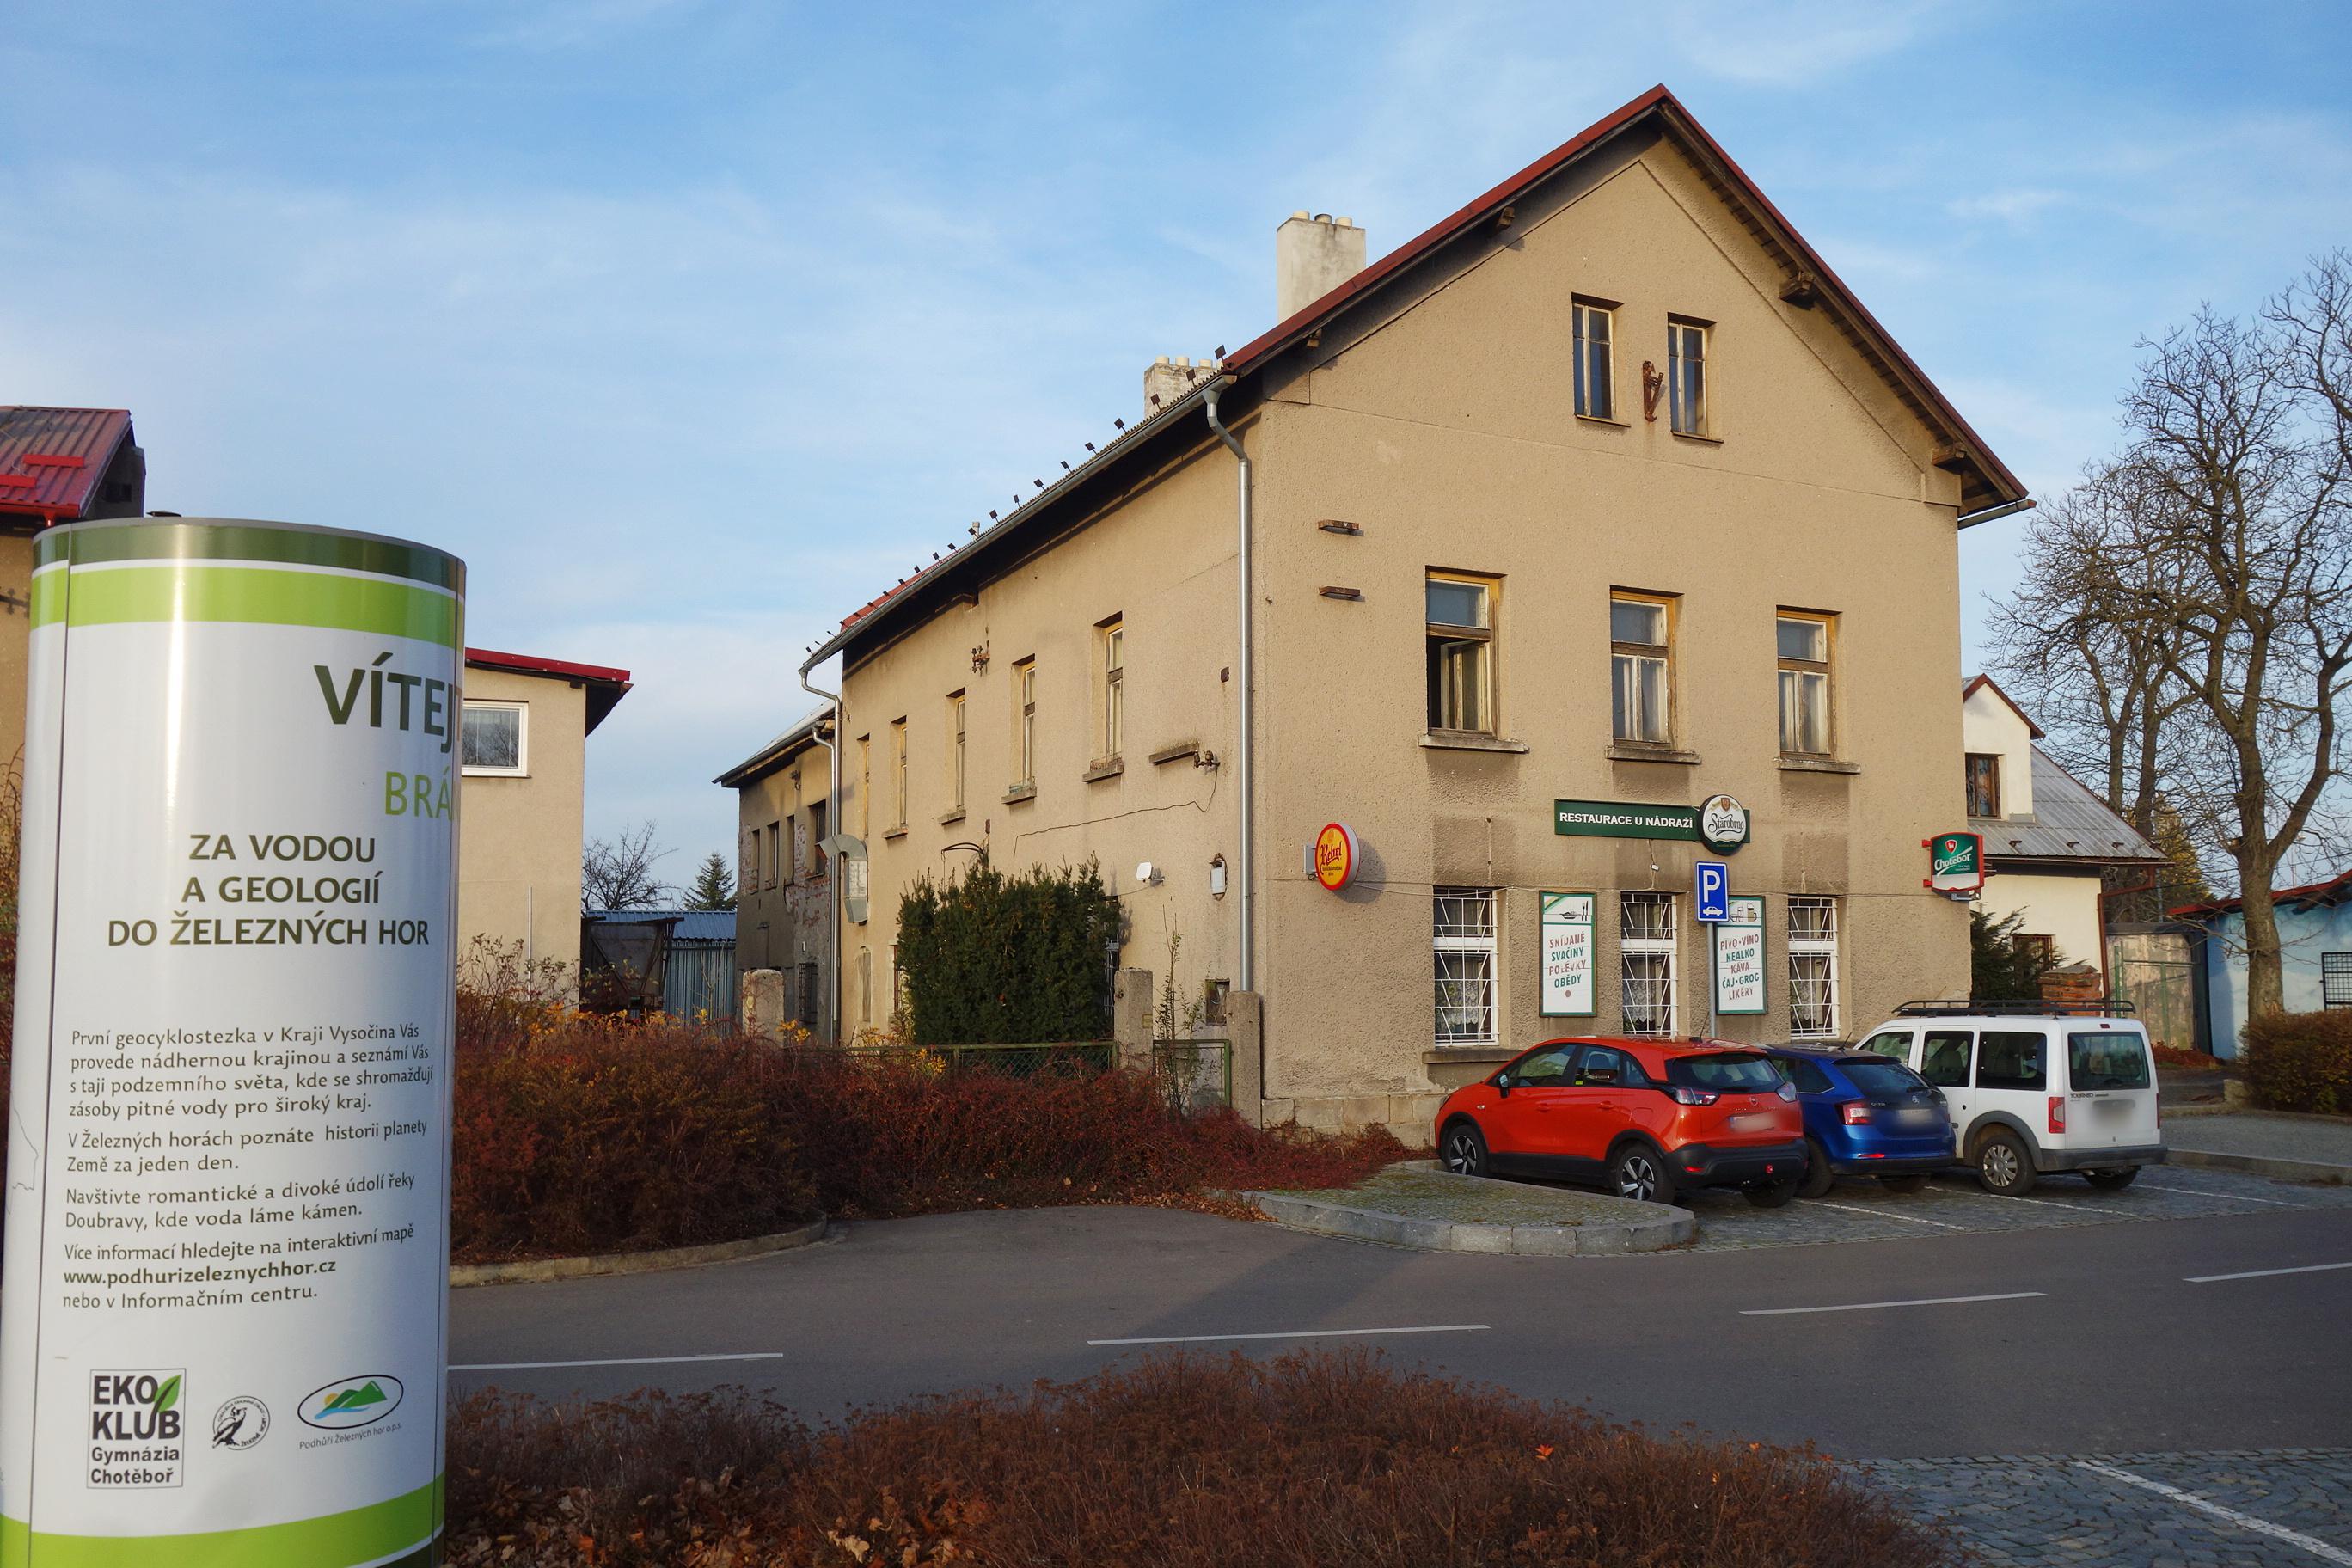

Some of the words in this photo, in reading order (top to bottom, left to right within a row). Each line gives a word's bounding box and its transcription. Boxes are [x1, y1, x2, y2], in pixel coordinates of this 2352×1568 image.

[1559, 812, 1632, 825] RESTAURACE
[1634, 817, 1643, 826] U
[1645, 815, 1693, 829] NÁDRAŽÍ
[1707, 812, 1744, 834] Starobrno
[189, 835, 236, 860] ZA
[249, 835, 375, 862] VODOU
[182, 877, 205, 902] A
[219, 871, 383, 903] GEOLOGIÍ
[1703, 870, 1720, 903] P
[109, 920, 157, 946] DO
[170, 910, 366, 945] ŽELEZNÝCH
[379, 920, 429, 945] HOR
[1726, 948, 1755, 963] NEALKO
[72, 1030, 110, 1045] První
[116, 1027, 256, 1050] geocyklostezka
[264, 1032, 273, 1042] v
[282, 1026, 322, 1045] Kraji
[330, 1025, 395, 1044] Vysočina
[400, 1023, 419, 1038] Vás
[71, 1053, 134, 1073] provede
[141, 1052, 246, 1068] nádhernou
[254, 1050, 330, 1069] krajinou
[337, 1053, 345, 1063] a
[352, 1045, 408, 1063] seznámí
[412, 1044, 428, 1059] Vás
[70, 1082, 76, 1093] s
[82, 1078, 105, 1097] taji
[112, 1075, 226, 1097] podzemního
[235, 1075, 288, 1091] světa,
[297, 1072, 327, 1087] kde
[334, 1075, 350, 1086] se
[356, 1066, 433, 1085] shromažďují
[70, 1100, 120, 1121] zásoby
[127, 1100, 174, 1120] pitné
[181, 1099, 227, 1118] vody
[235, 1103, 267, 1118] pro
[276, 1094, 330, 1114] široký
[337, 1093, 371, 1112] kraj.
[69, 1133, 77, 1148] V
[82, 1129, 161, 1152] Železných
[169, 1130, 232, 1147] horách
[241, 1128, 314, 1149] poznáte
[326, 1123, 378, 1140] historii
[384, 1120, 426, 1141] planety
[67, 1156, 107, 1172] Země
[114, 1161, 132, 1172] za
[137, 1155, 188, 1176] jeden
[198, 1155, 238, 1170] den.
[67, 1189, 140, 1204] Navštivte
[149, 1185, 257, 1203] romantické
[265, 1189, 274, 1199] a
[282, 1179, 340, 1197] divoké
[346, 1174, 384, 1192] údolí
[389, 1172, 414, 1190] řeky
[66, 1212, 147, 1232] Doubravy,
[156, 1211, 187, 1227] kde
[196, 1210, 242, 1226] voda
[251, 1208, 294, 1223] láme
[303, 1204, 362, 1219] kámen.
[65, 1244, 92, 1259] Více
[98, 1243, 176, 1259] informací
[182, 1241, 254, 1261] hledejte
[260, 1243, 281, 1254] na
[288, 1228, 377, 1252] interaktivní
[382, 1223, 413, 1243] mapě
[64, 1261, 335, 1289] www.podhurizeleznychhor.cz
[64, 1292, 100, 1308] nebo
[107, 1298, 115, 1308] v
[122, 1289, 242, 1308] Informačním
[251, 1287, 317, 1302] centru.
[94, 1375, 158, 1405] EKO
[92, 1410, 181, 1440] KLUB
[299, 1436, 333, 1449] Podhůří
[334, 1429, 371, 1444] Železných
[373, 1426, 385, 1435] hor
[92, 1446, 179, 1466] Gymnázia
[91, 1468, 173, 1484] Chotěboř
